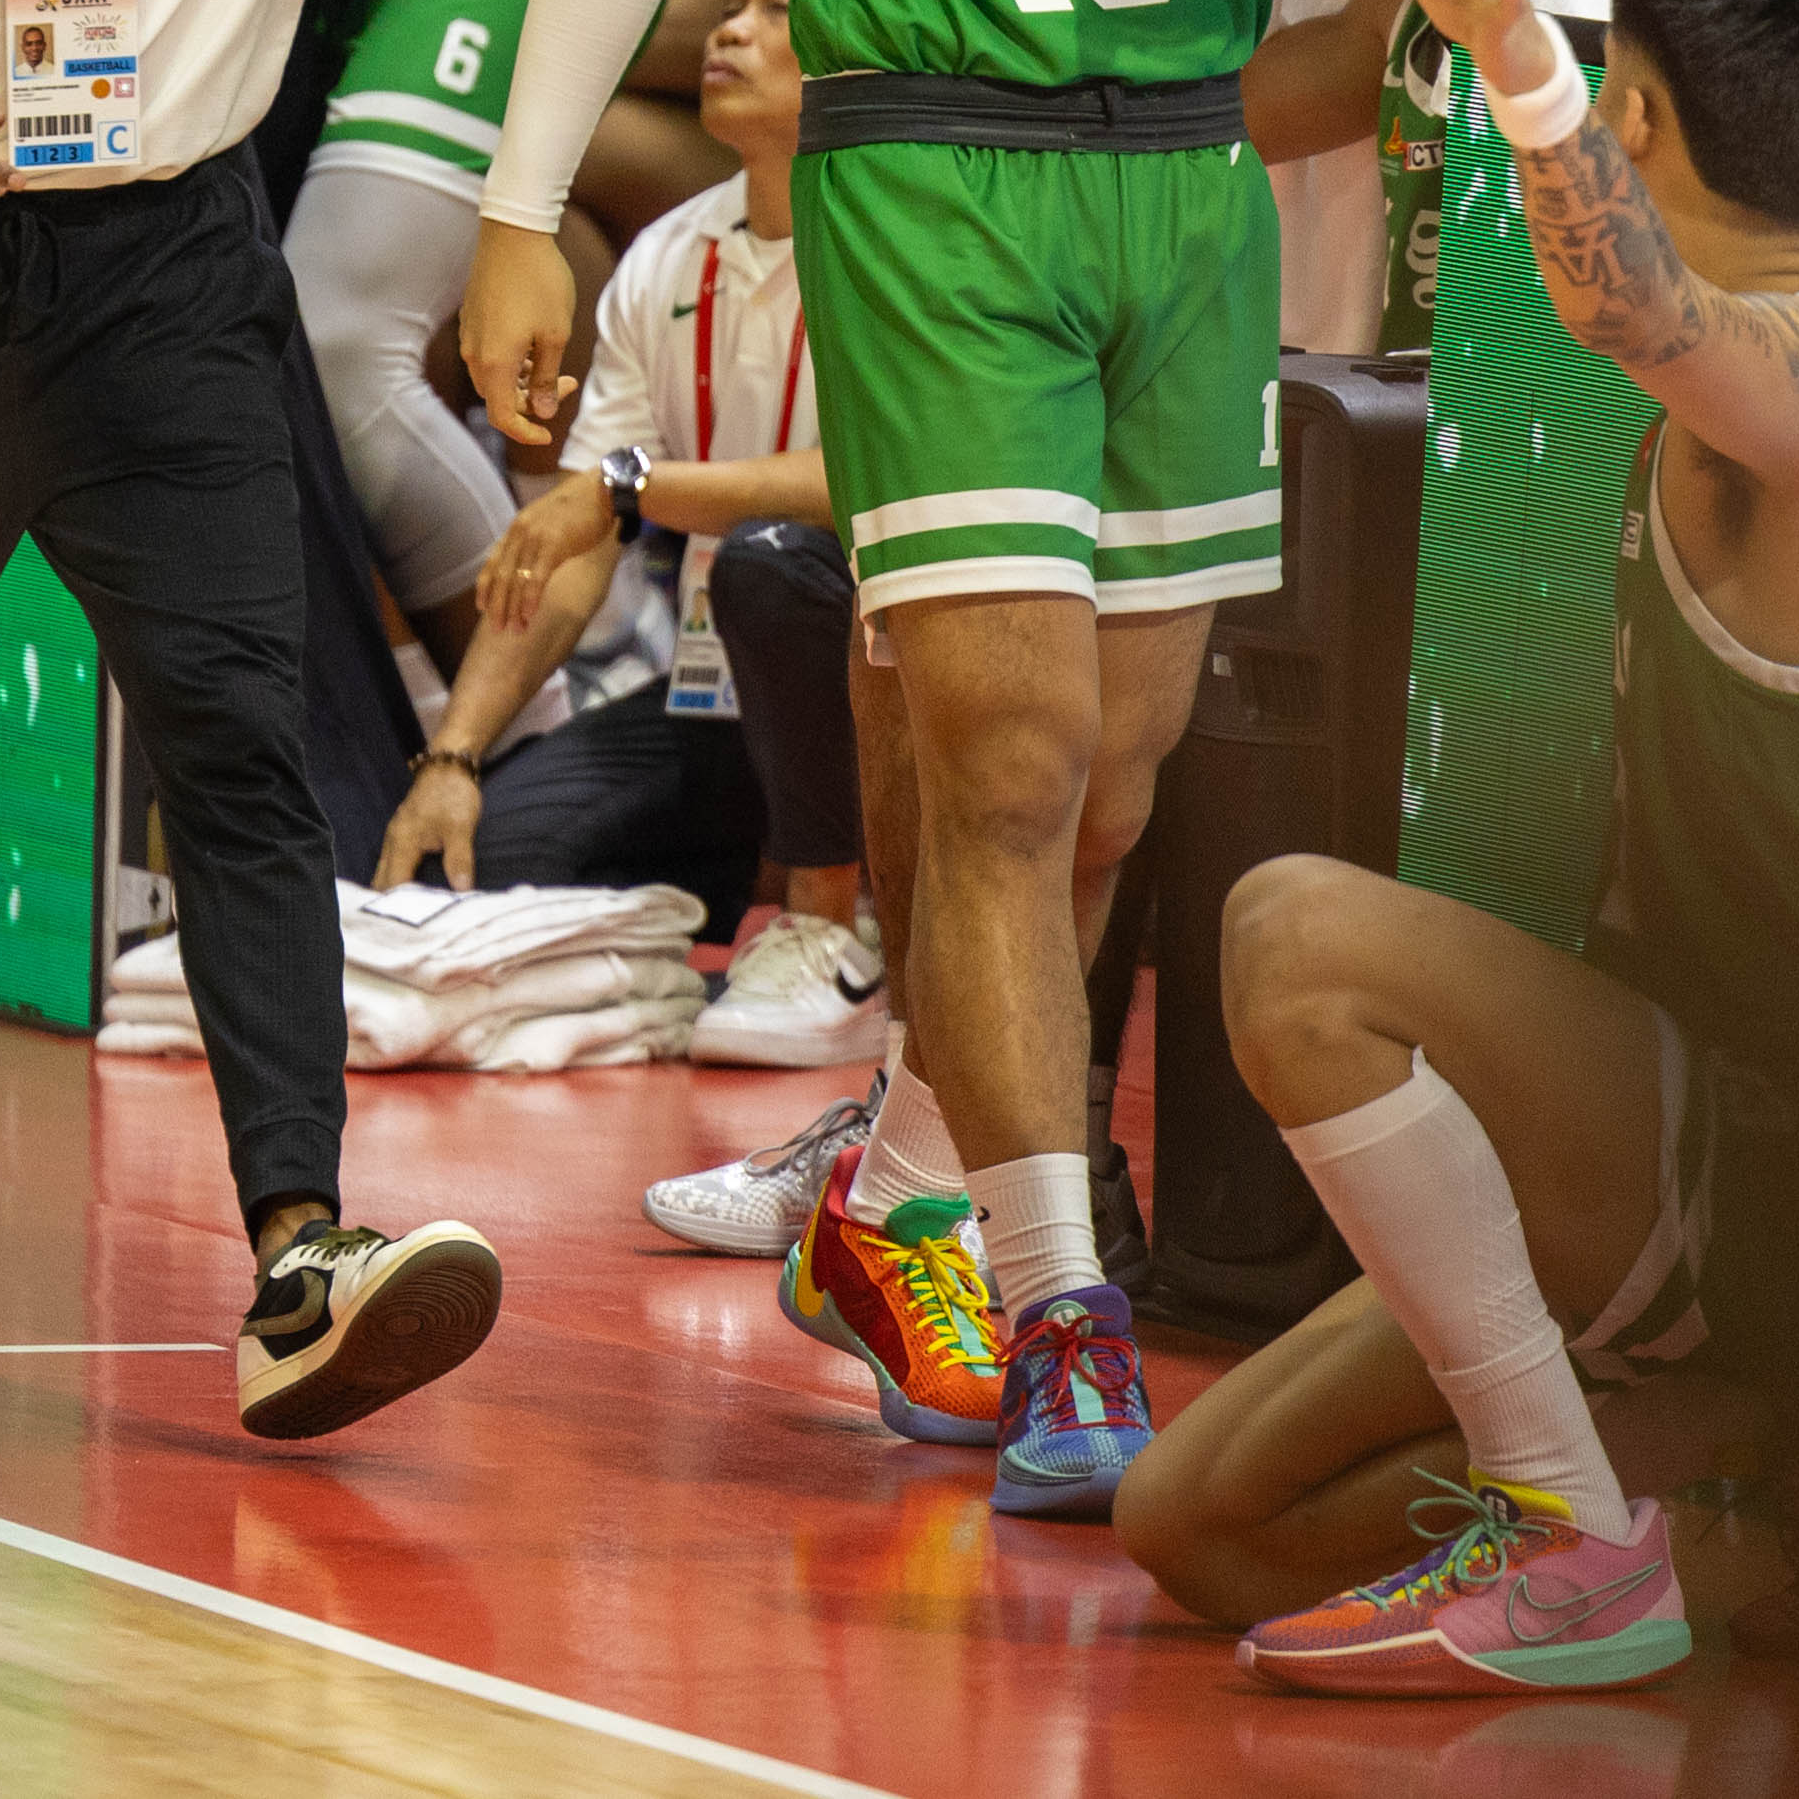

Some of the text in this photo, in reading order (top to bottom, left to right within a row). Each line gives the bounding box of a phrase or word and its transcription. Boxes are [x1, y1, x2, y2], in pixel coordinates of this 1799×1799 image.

[68, 59, 131, 74] BASKETBALL
[434, 17, 490, 94] 6
[106, 124, 129, 155] C
